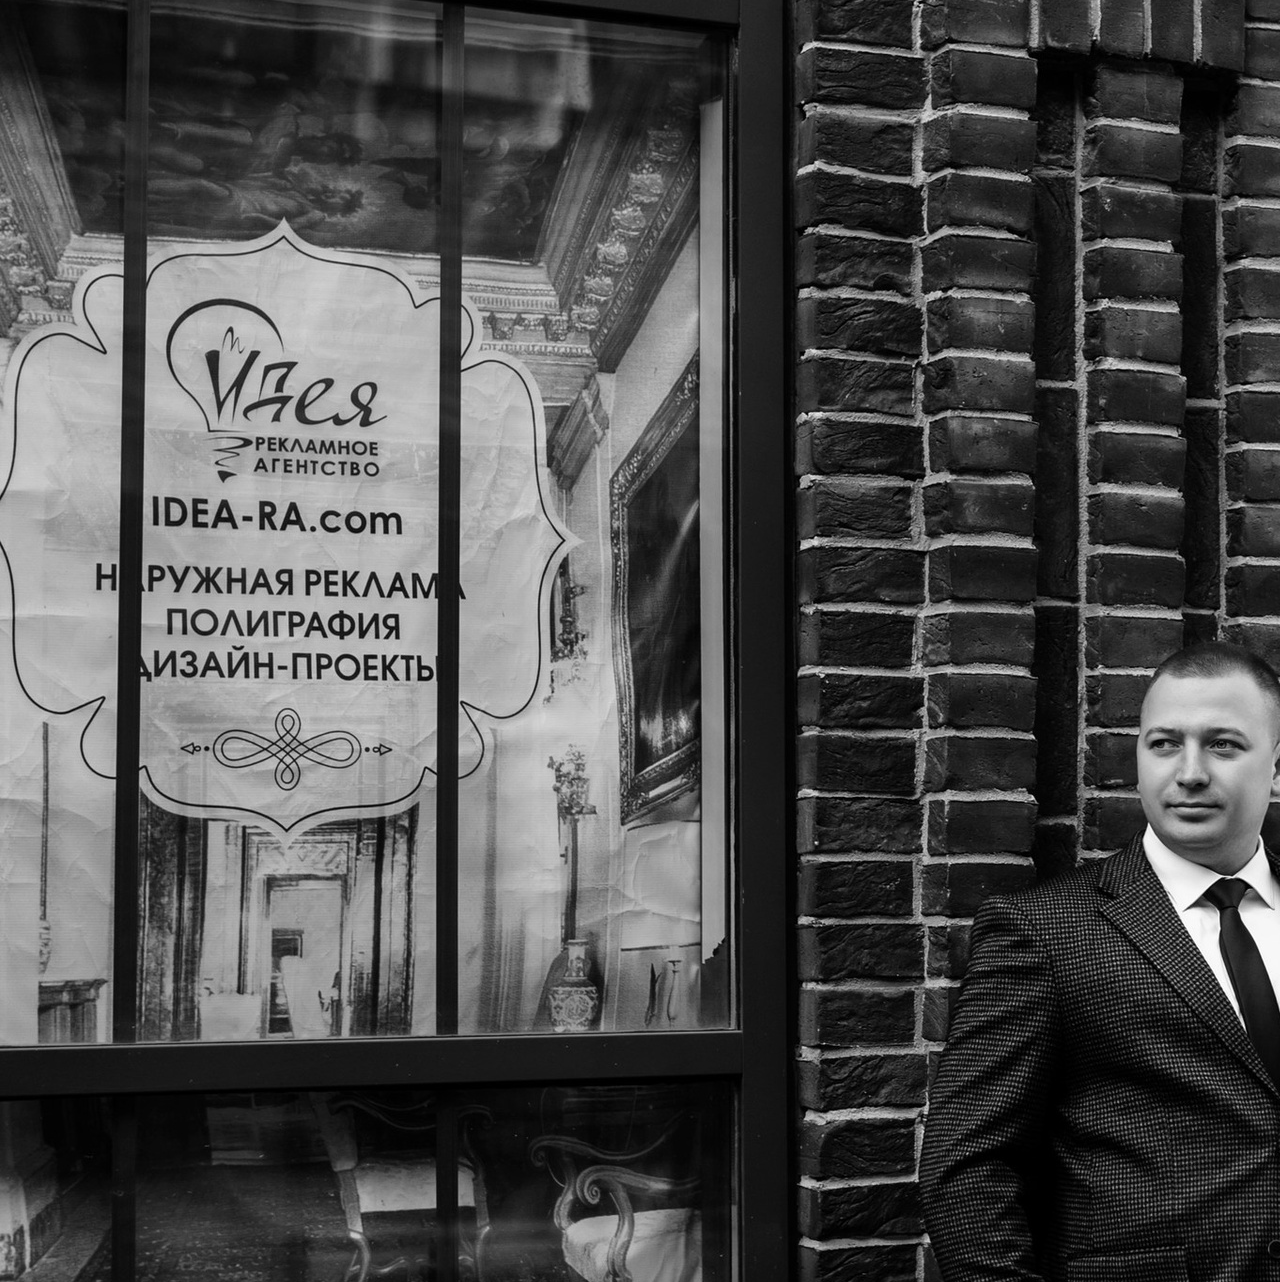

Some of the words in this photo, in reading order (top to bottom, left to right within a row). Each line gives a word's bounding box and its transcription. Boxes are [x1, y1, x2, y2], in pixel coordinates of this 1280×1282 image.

[255, 436, 379, 456] РЕКЛАМНОЕ
[253, 457, 380, 477] АГЕНТСТВО
[152, 495, 403, 535] IDEA-RA.com
[95, 563, 294, 596] НРУЖНАЯ
[304, 569, 467, 600] РЕКЛАМ
[167, 608, 401, 640] ПОЛИГРАФИЯ
